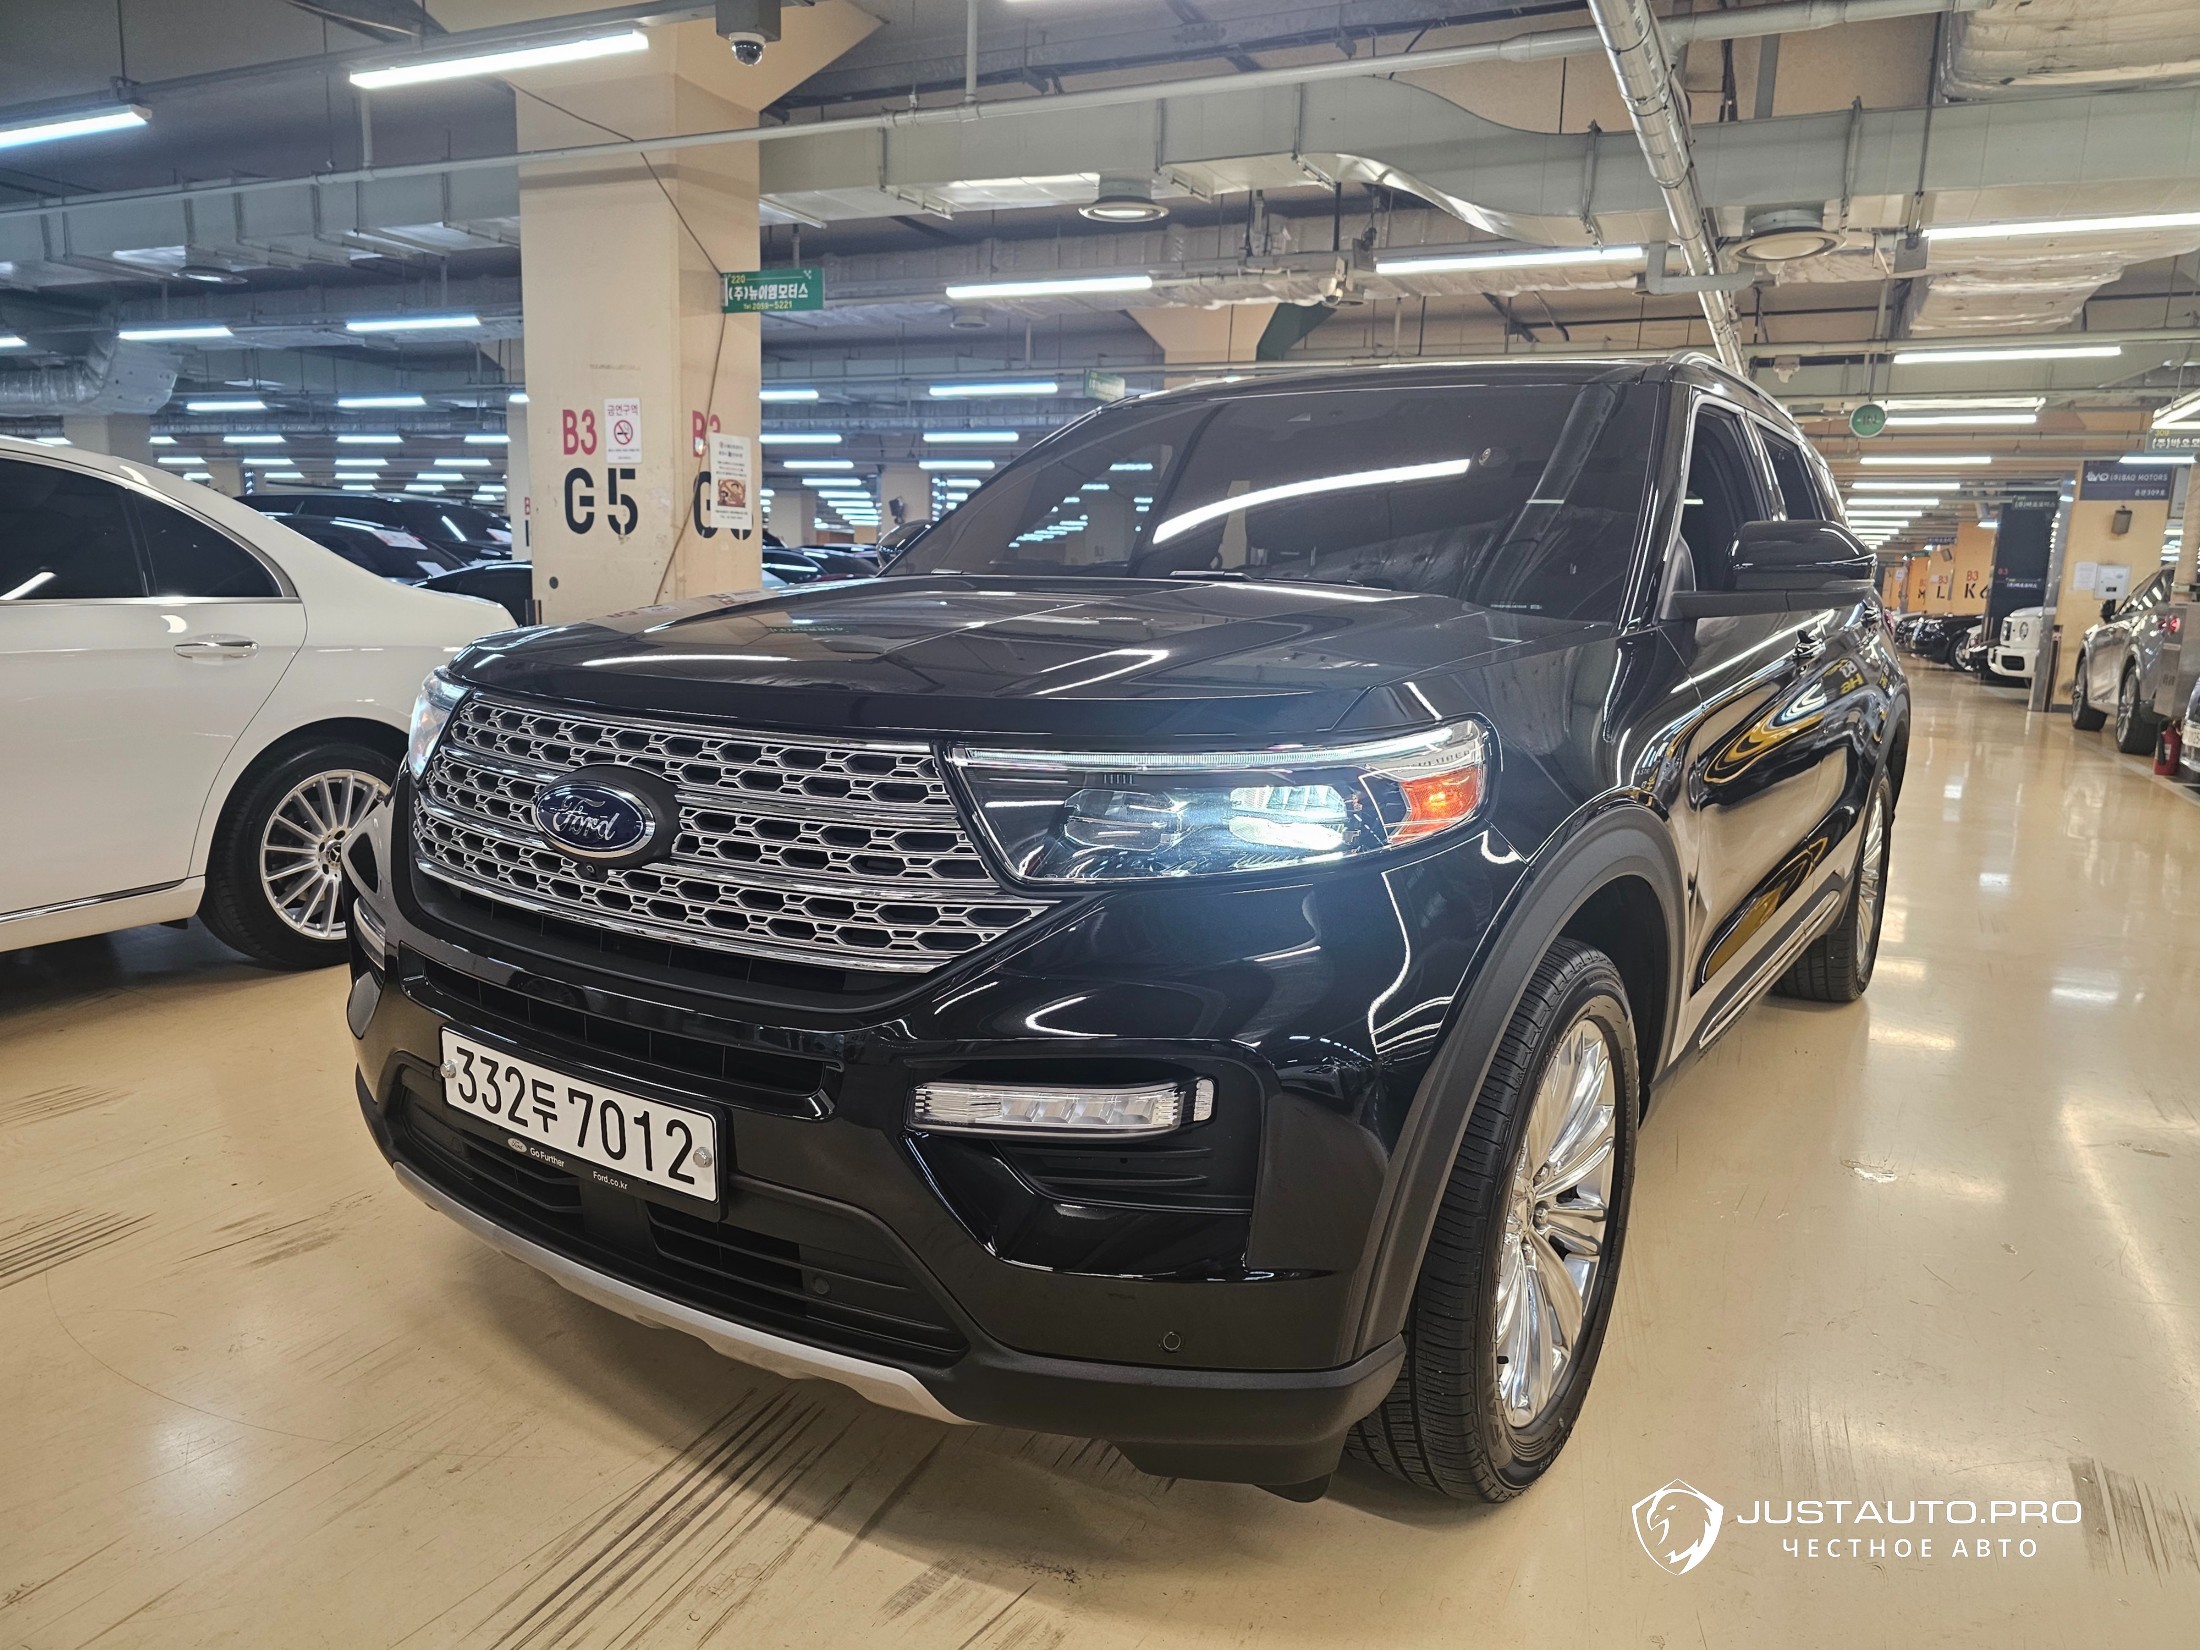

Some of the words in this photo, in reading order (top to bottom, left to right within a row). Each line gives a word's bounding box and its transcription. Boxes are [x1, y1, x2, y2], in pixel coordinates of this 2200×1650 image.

[608, 404, 639, 416] 금연구역
[562, 409, 597, 455] B3
[2138, 472, 2168, 481] MOTORS
[564, 467, 638, 536] G5
[1966, 570, 1978, 581] B3
[551, 794, 620, 841] Ford
[530, 1147, 540, 1158] Go
[541, 1151, 565, 1168] Further
[592, 1170, 628, 1190] Ford.co.kr
